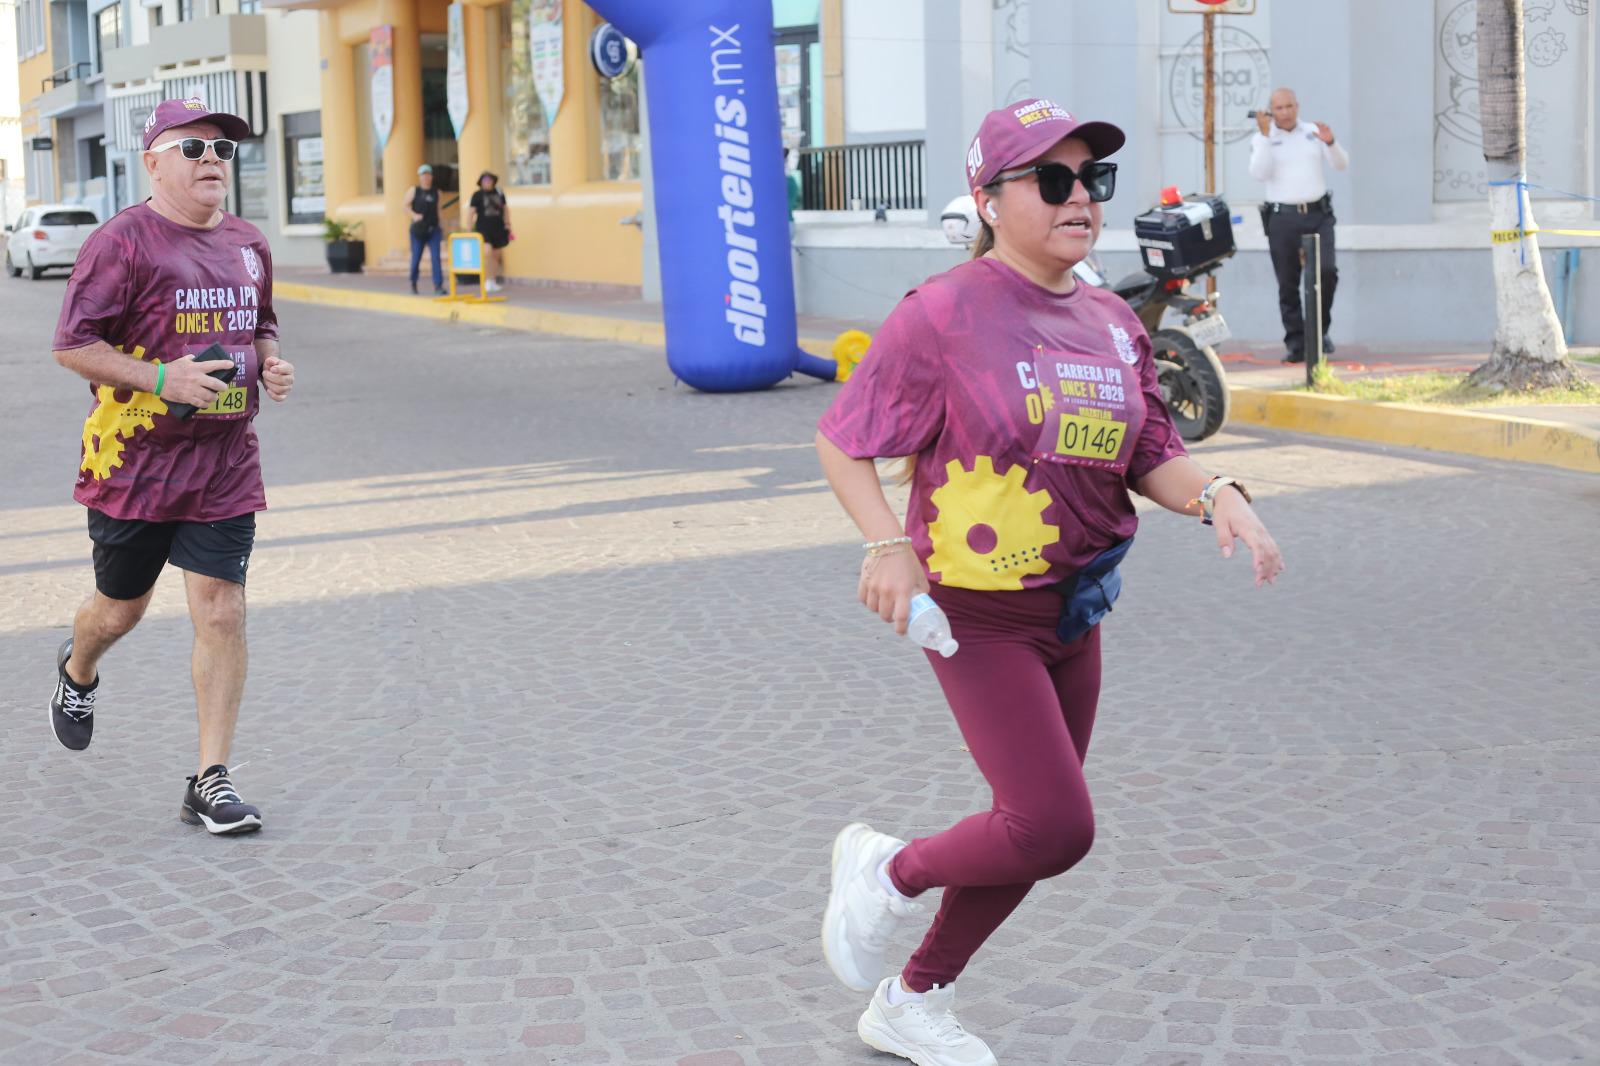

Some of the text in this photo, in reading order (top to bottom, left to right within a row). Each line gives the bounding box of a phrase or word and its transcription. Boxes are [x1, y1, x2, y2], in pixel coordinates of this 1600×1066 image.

[967, 137, 983, 177] 90
[709, 24, 767, 347] dportenis.mx
[175, 287, 236, 310] CARRERA
[175, 312, 209, 334] ONCE
[213, 311, 224, 332] K
[237, 363, 246, 375] 26
[1055, 363, 1104, 382] CARRERA
[1105, 367, 1122, 385] IPN
[203, 391, 243, 411] 148
[1060, 380, 1125, 402] ONCE K 2026
[1064, 421, 1119, 454] 0146
